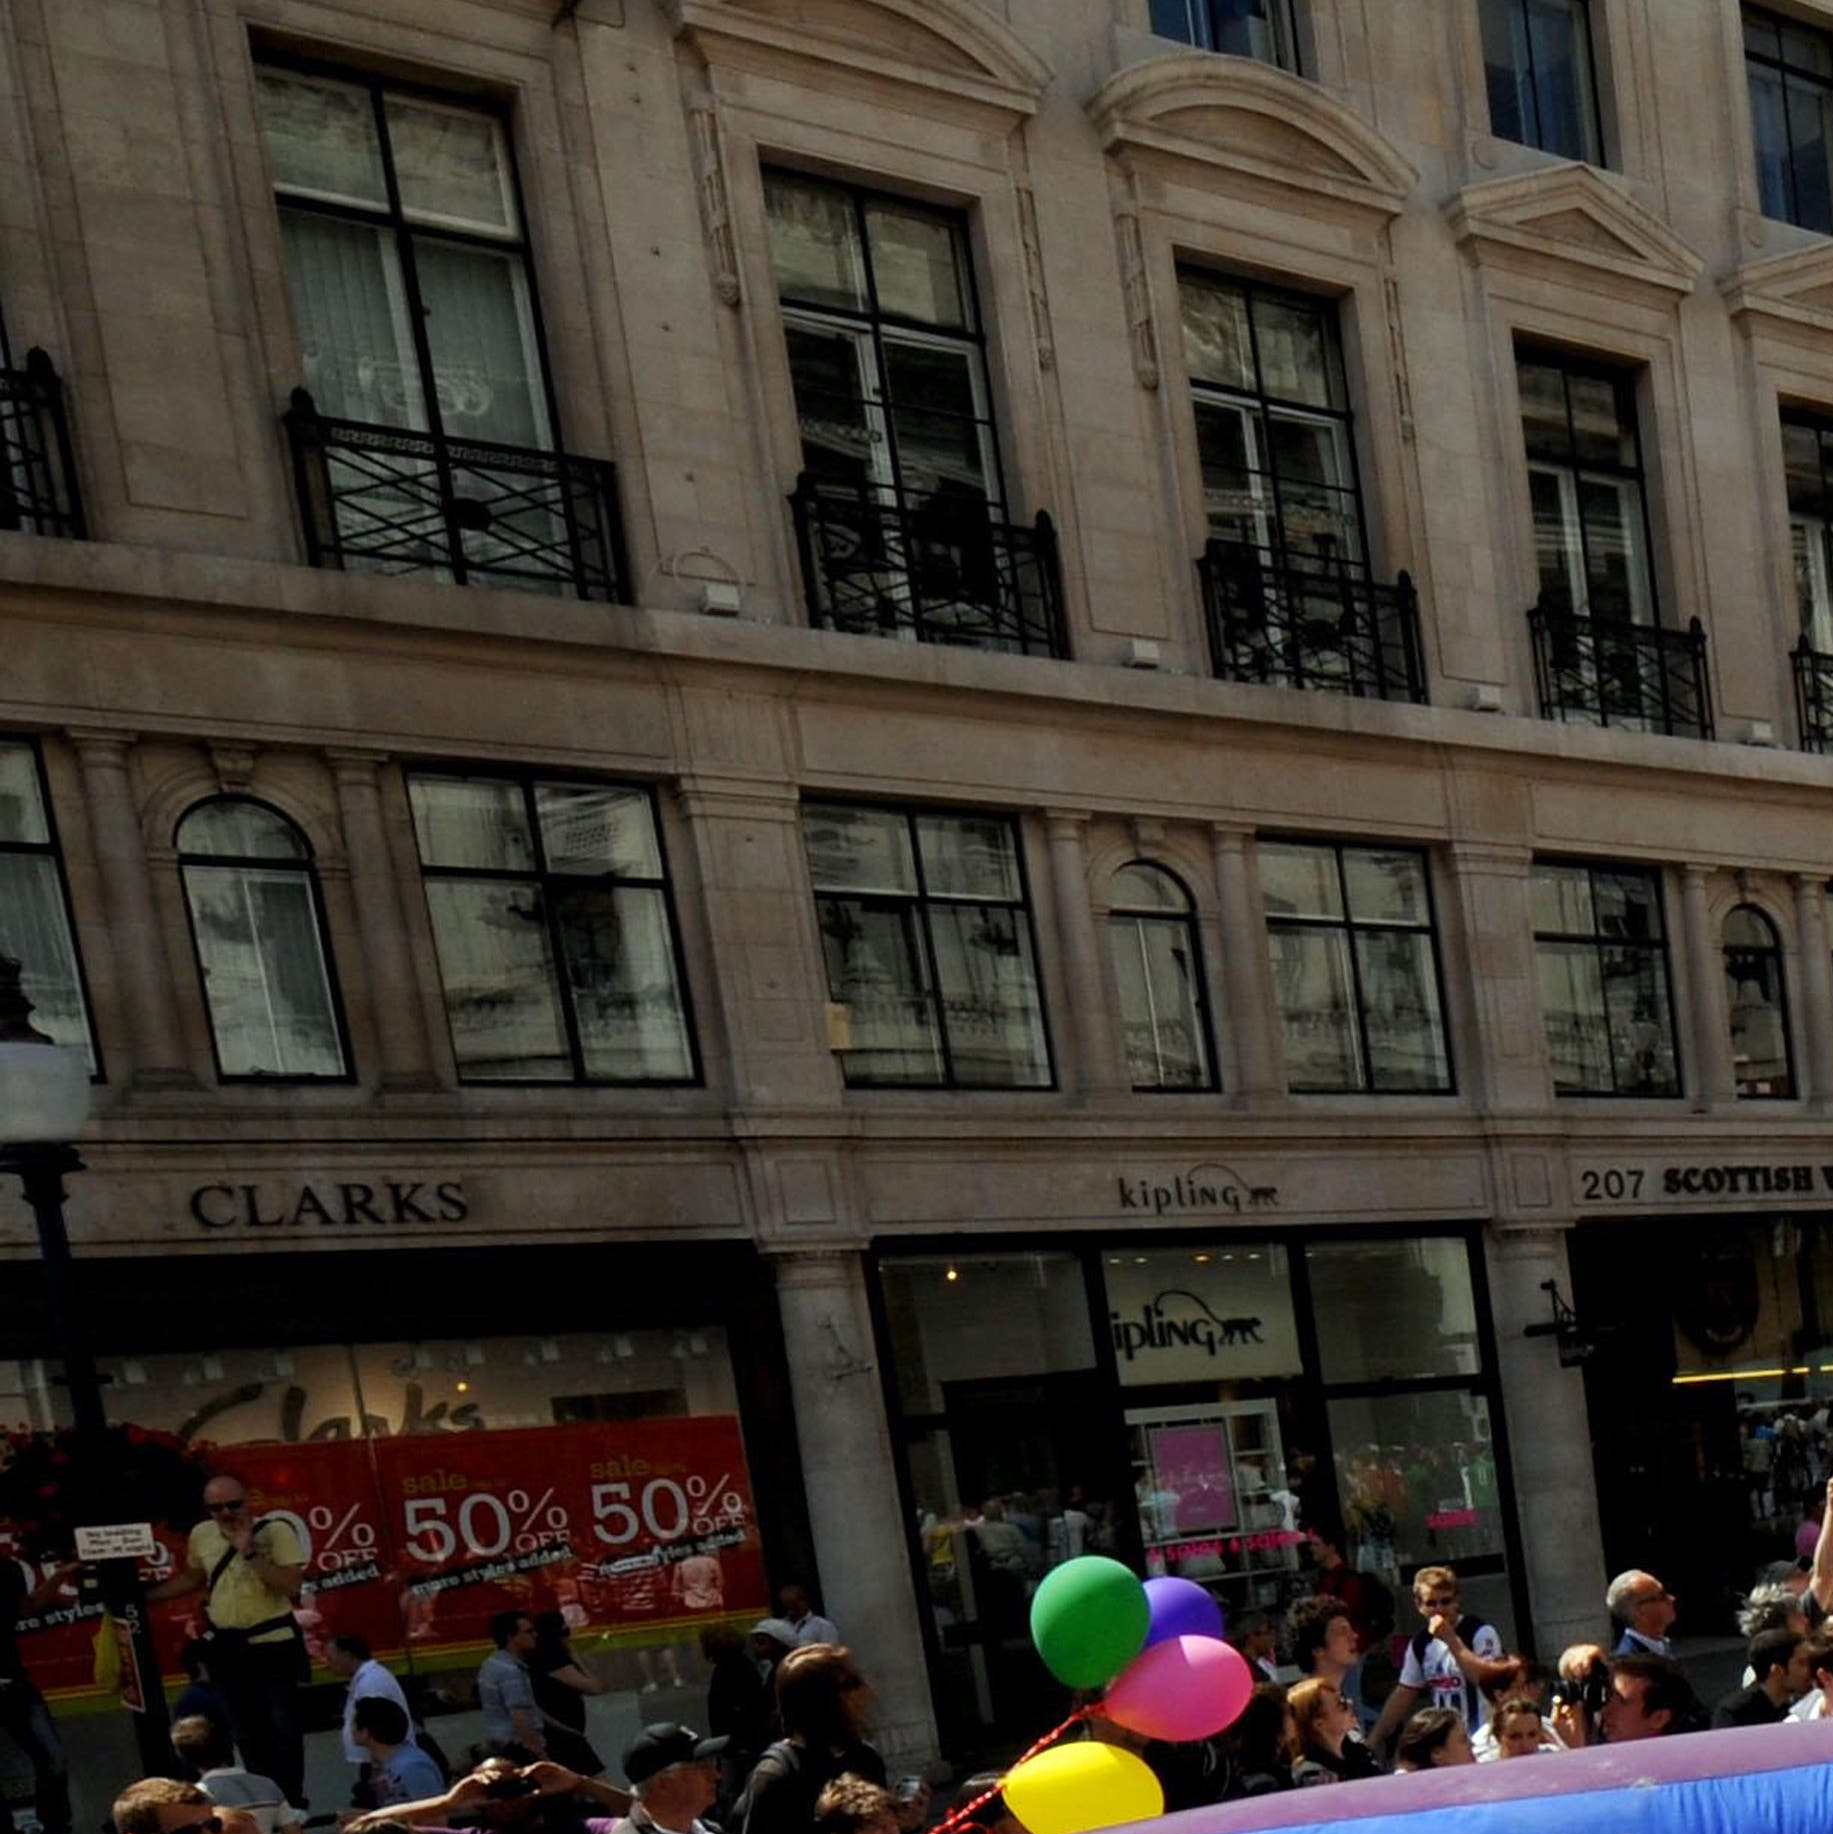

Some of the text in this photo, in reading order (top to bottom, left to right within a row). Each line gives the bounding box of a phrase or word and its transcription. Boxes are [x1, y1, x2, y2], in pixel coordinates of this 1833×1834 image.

[1118, 1177, 1240, 1213] kipling
[1581, 1170, 1645, 1199] 207
[1663, 1167, 1815, 1194] SCOTTISH
[190, 1182, 469, 1229] CLARKS
[1111, 1305, 1216, 1360] ipling
[402, 1468, 467, 1494] sale
[591, 1457, 650, 1478] sale
[403, 1487, 569, 1563] 50%
[591, 1472, 743, 1544] 50%
[321, 1563, 381, 1589] added
[462, 1560, 516, 1584] styles
[518, 1544, 574, 1571] added
[45, 1601, 106, 1626] styles
